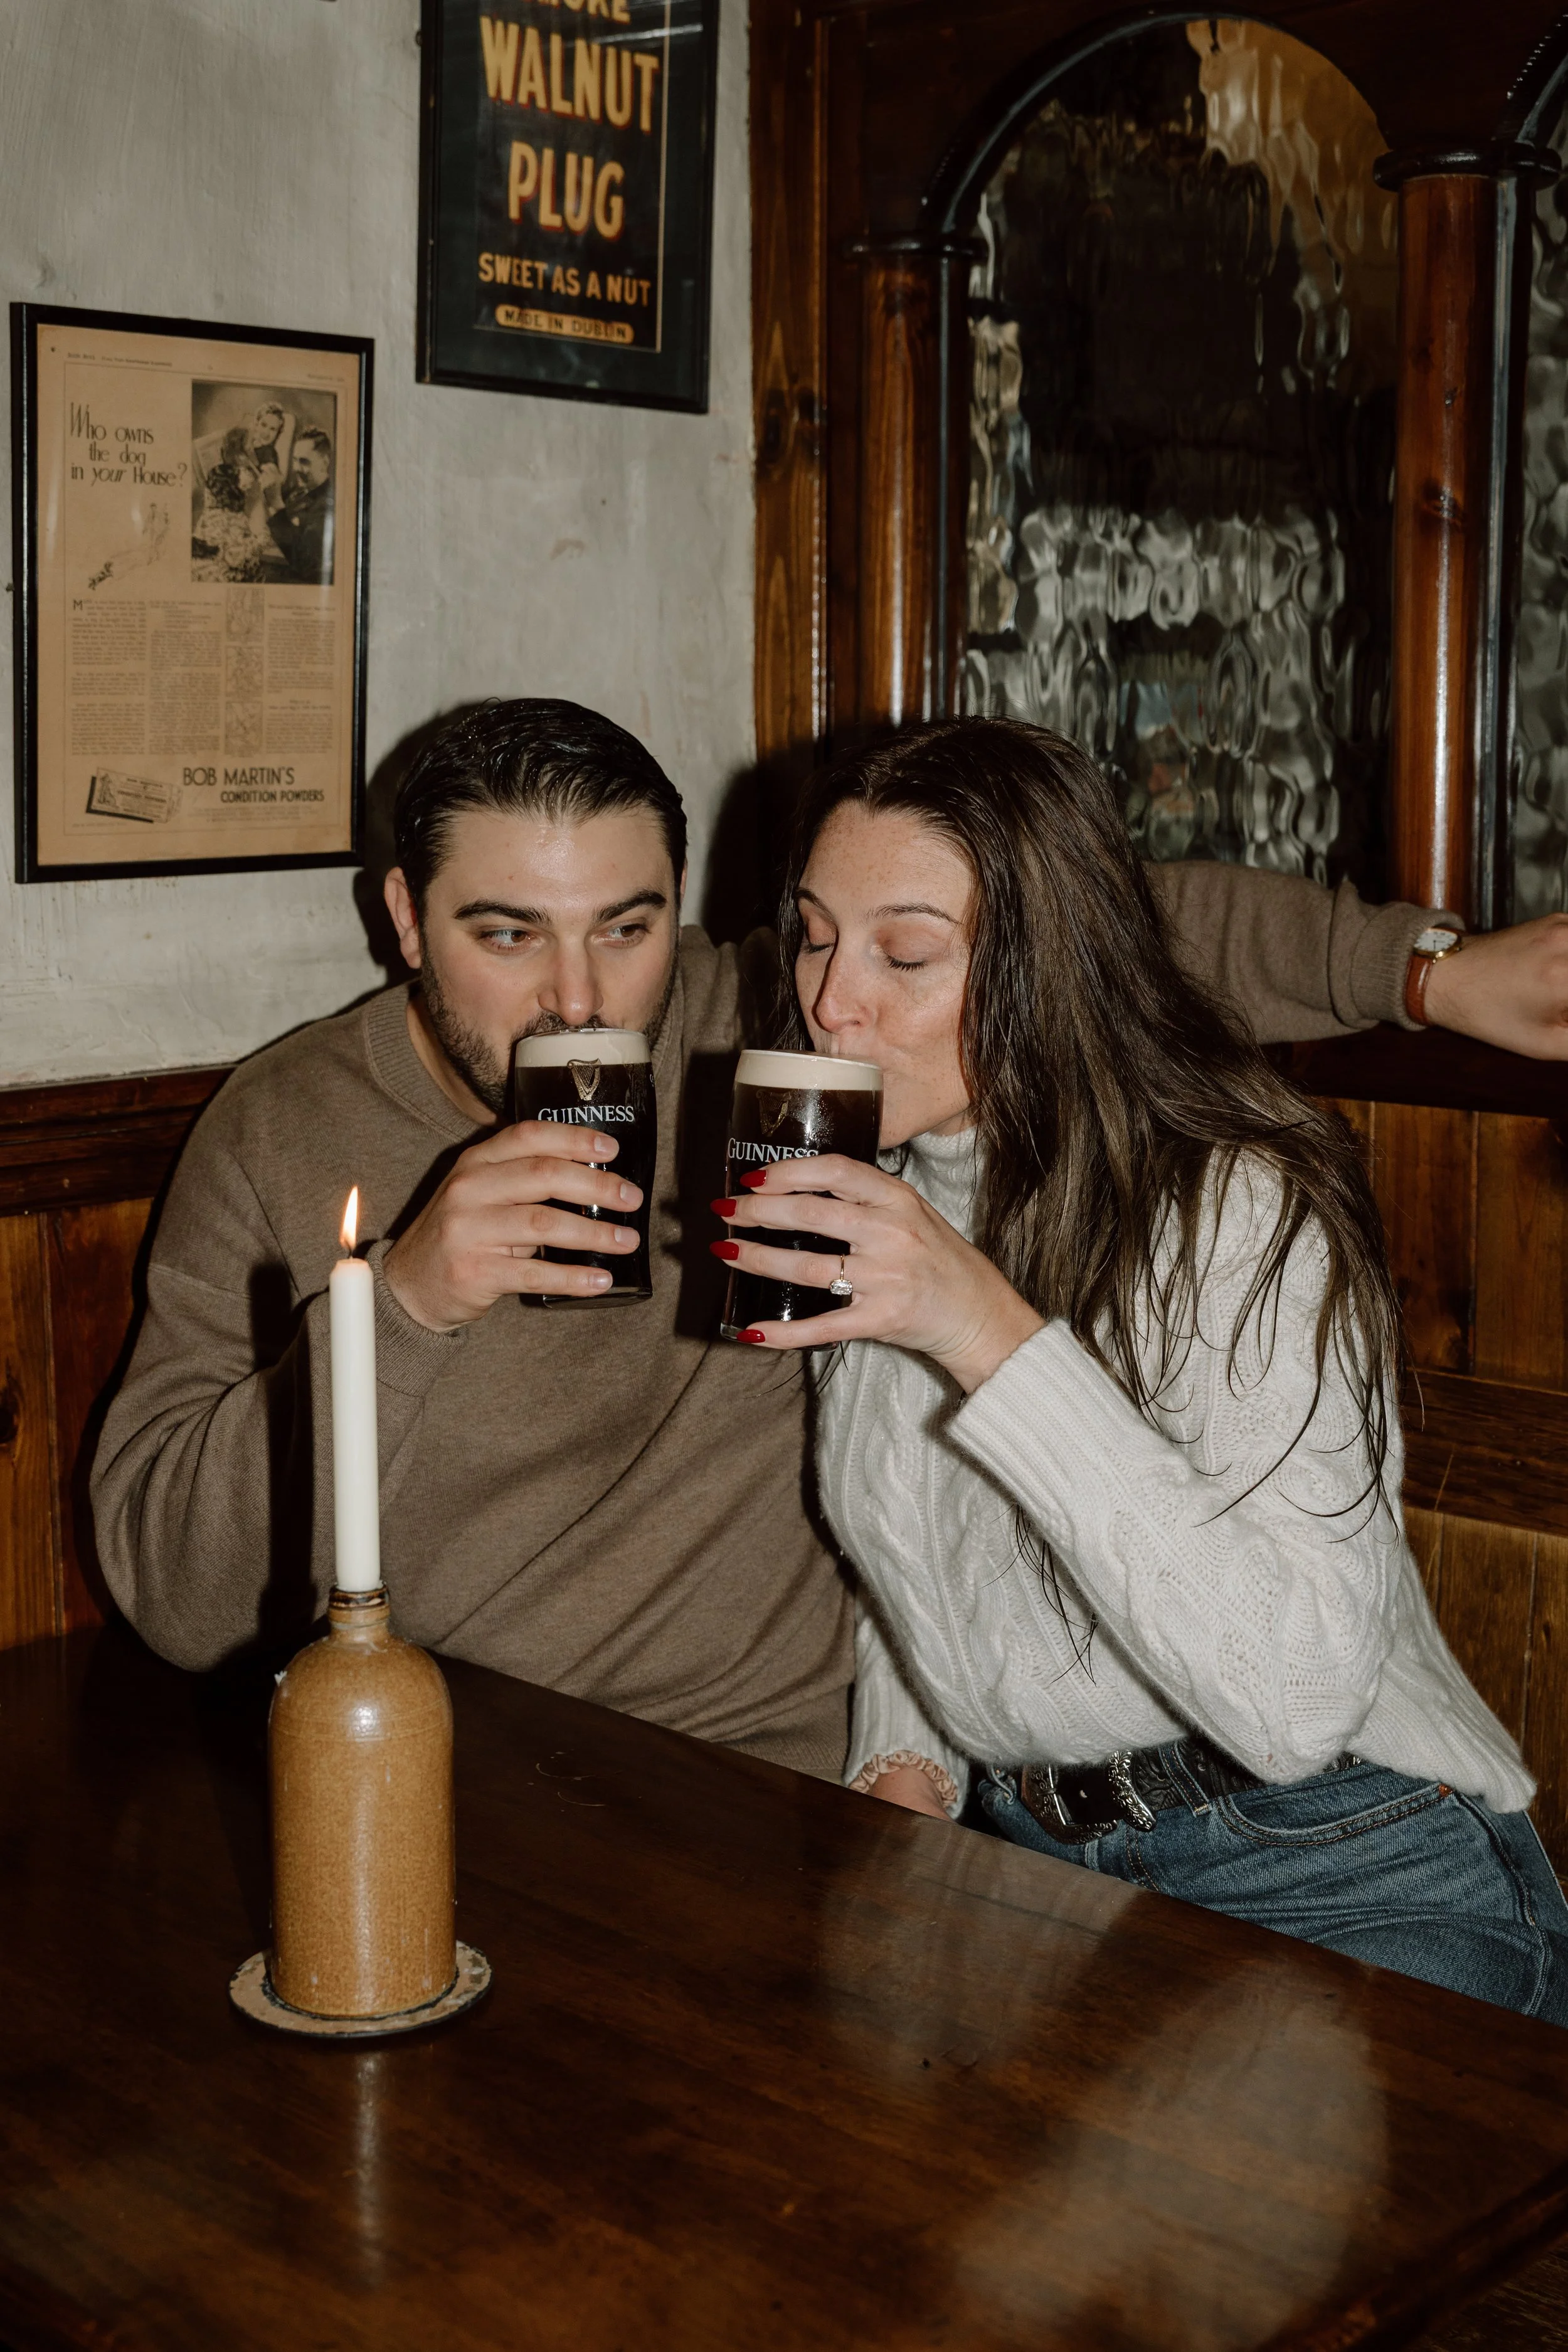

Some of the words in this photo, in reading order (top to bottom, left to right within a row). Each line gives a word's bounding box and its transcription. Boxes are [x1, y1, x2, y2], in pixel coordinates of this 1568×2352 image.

[480, 15, 659, 132] WALNUT
[507, 140, 625, 240] PLUG
[477, 252, 548, 290] SWEET
[551, 264, 581, 297] AS
[585, 270, 602, 300] A
[606, 273, 651, 307] NUT
[504, 309, 543, 328] MADE
[548, 315, 564, 331] IN
[571, 318, 627, 340] DUBLIN
[70, 401, 107, 440] Who
[115, 425, 154, 445] owns
[89, 440, 110, 463] the
[119, 443, 146, 467] dog
[71, 462, 84, 480] in
[91, 467, 127, 487] your
[134, 462, 188, 487] House?
[183, 766, 217, 786] BOB
[223, 766, 295, 786] MARTIN'S
[221, 790, 277, 803] CONDITION
[280, 788, 325, 802] POWDERS
[538, 1105, 635, 1124] GUINNESS
